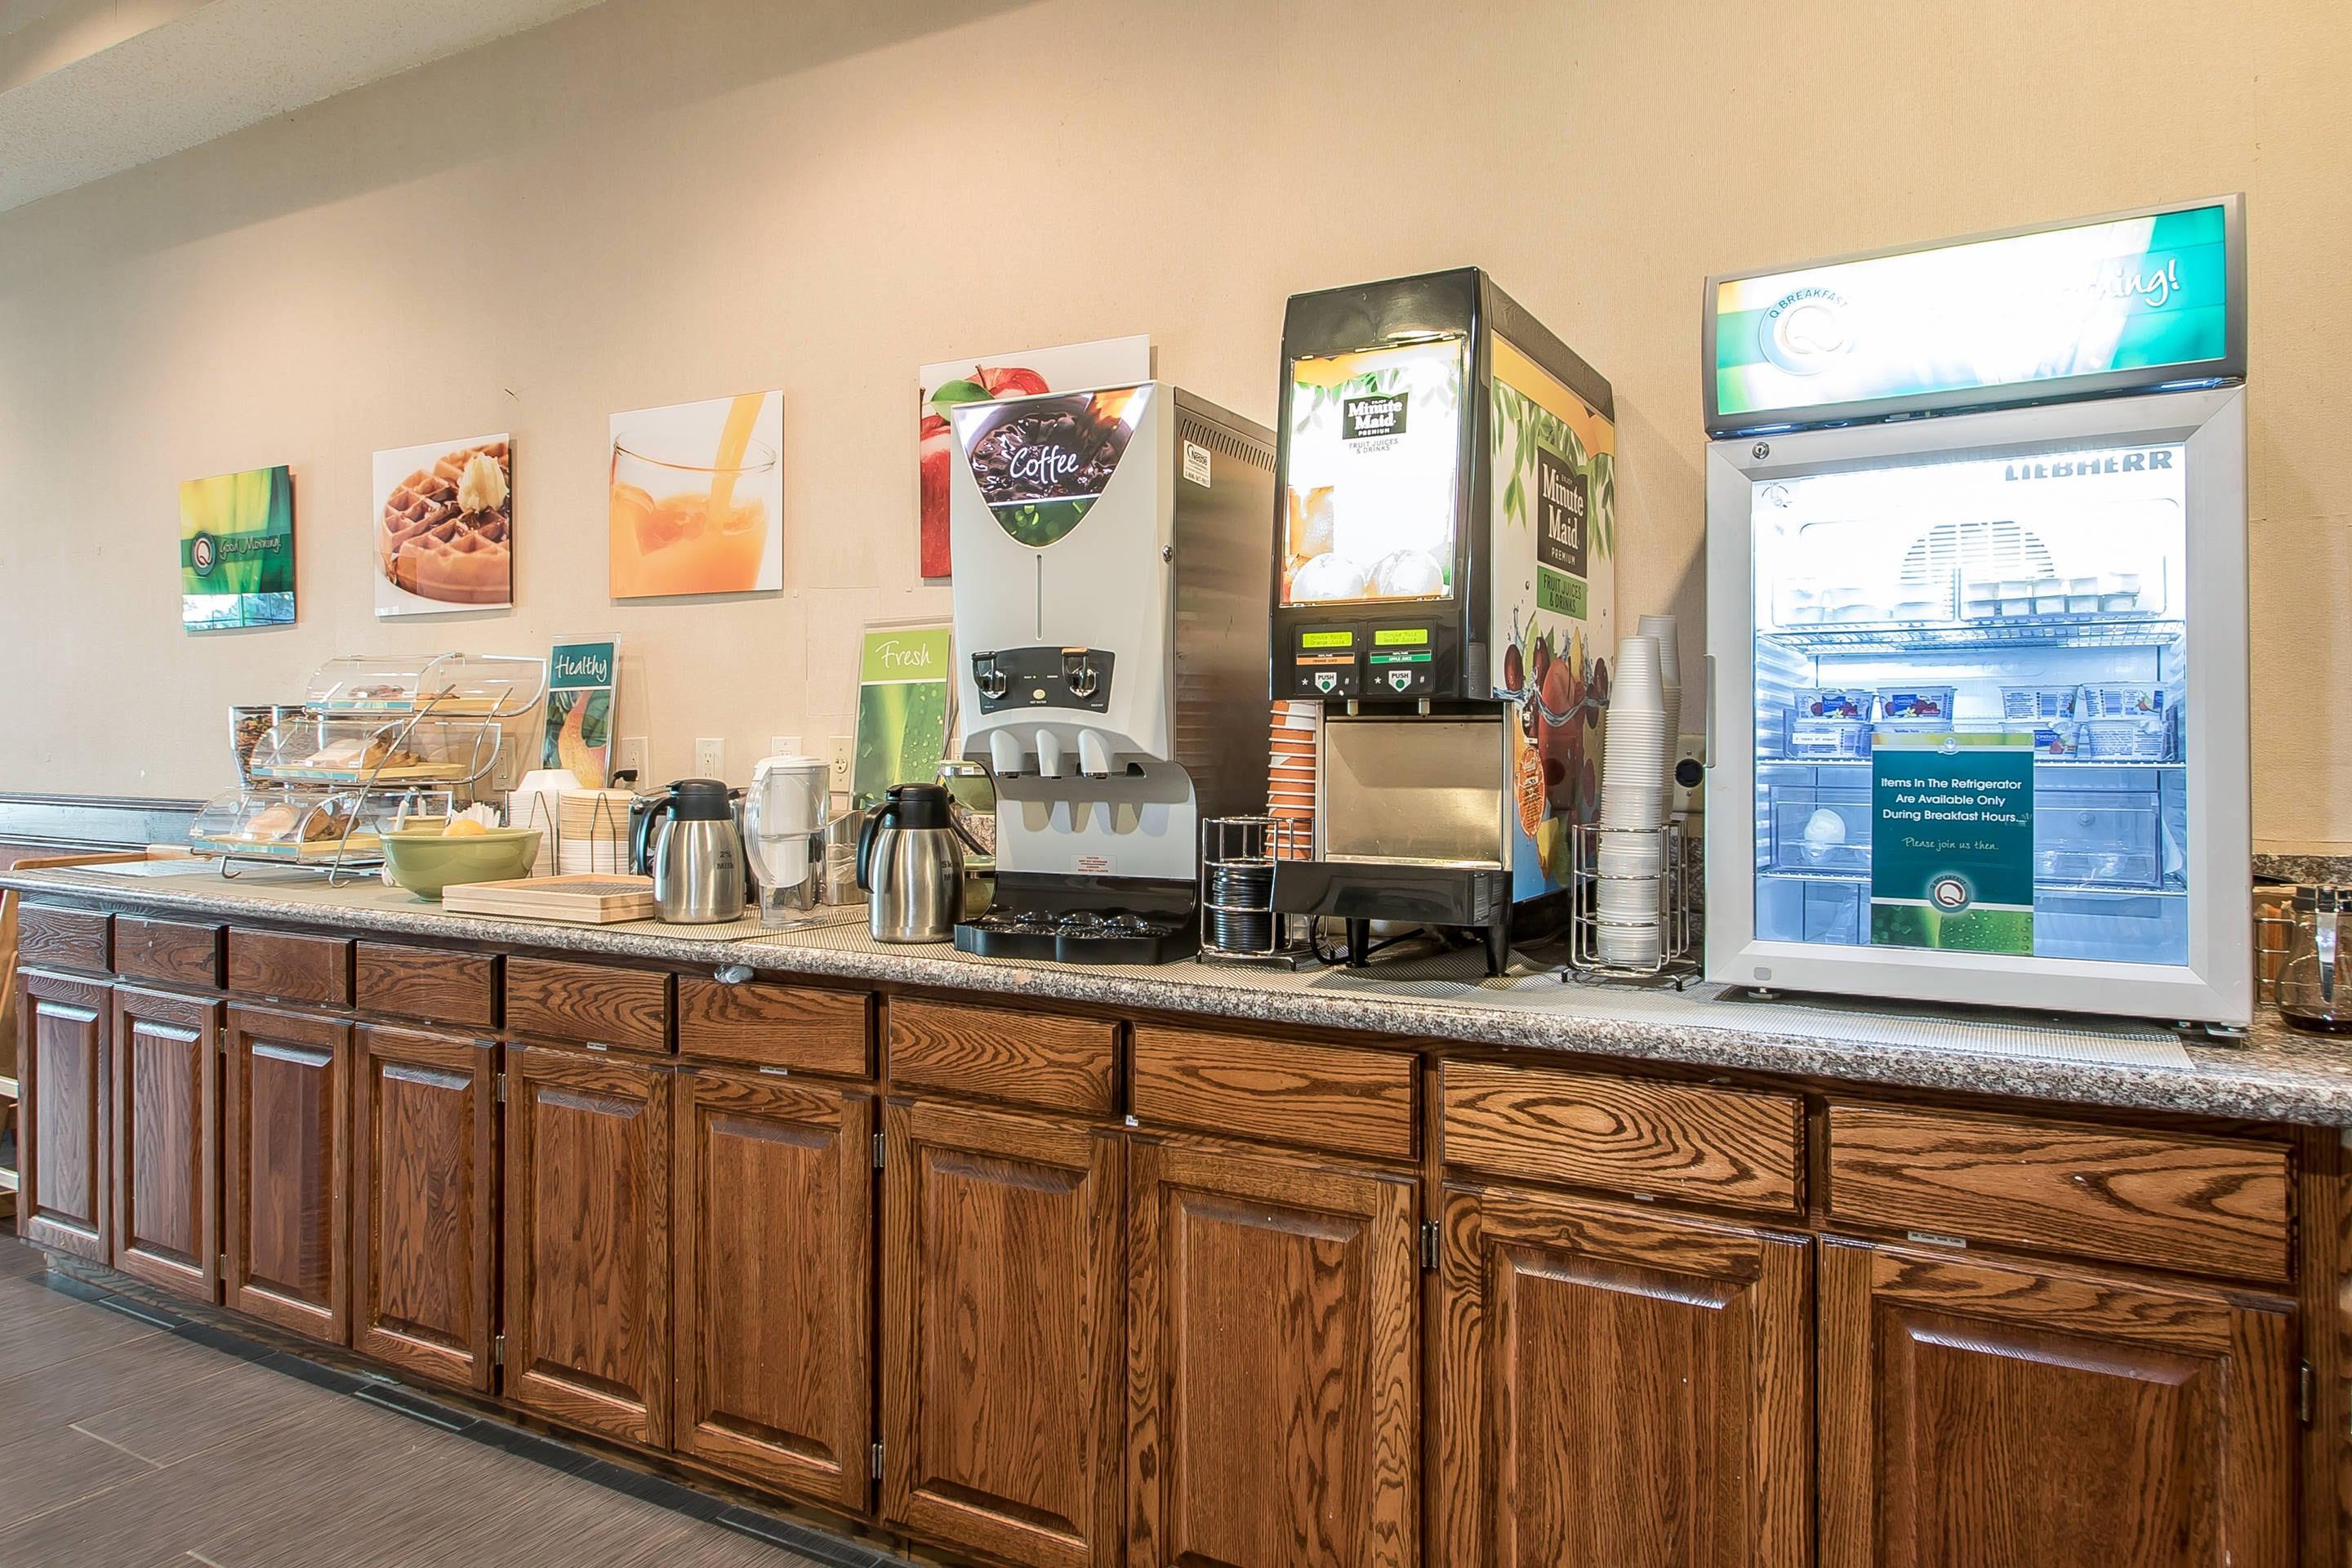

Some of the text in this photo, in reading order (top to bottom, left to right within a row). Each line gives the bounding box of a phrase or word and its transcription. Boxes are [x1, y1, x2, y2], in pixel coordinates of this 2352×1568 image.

[1769, 288, 1848, 318] Q BREAKFAST
[1348, 399, 1403, 417] Minute
[1354, 412, 1394, 430] Maid
[1358, 428, 1390, 436] PREMIUM
[1349, 438, 1398, 449] FRUIT JUICES
[1009, 444, 1080, 484] Coffee
[2005, 450, 2173, 482] LIEBHERR
[1542, 463, 1584, 516] Minute
[1548, 504, 1579, 550] Maid
[196, 540, 213, 566] Q
[1552, 547, 1576, 565] PREMIUM
[1544, 573, 1582, 600] FRUIT JUICES
[1549, 591, 1576, 613] & DRINKS
[875, 640, 932, 668] Fresh
[555, 655, 608, 683] Healthy
[1882, 778, 2022, 791] Items In The Refrigerator
[1895, 794, 2006, 807] Are Available Only
[1882, 809, 1921, 822] During
[1924, 810, 1978, 821] Breakfast
[1901, 836, 1936, 848] Please
[1936, 839, 1956, 852] join
[1974, 840, 1999, 850] then.
